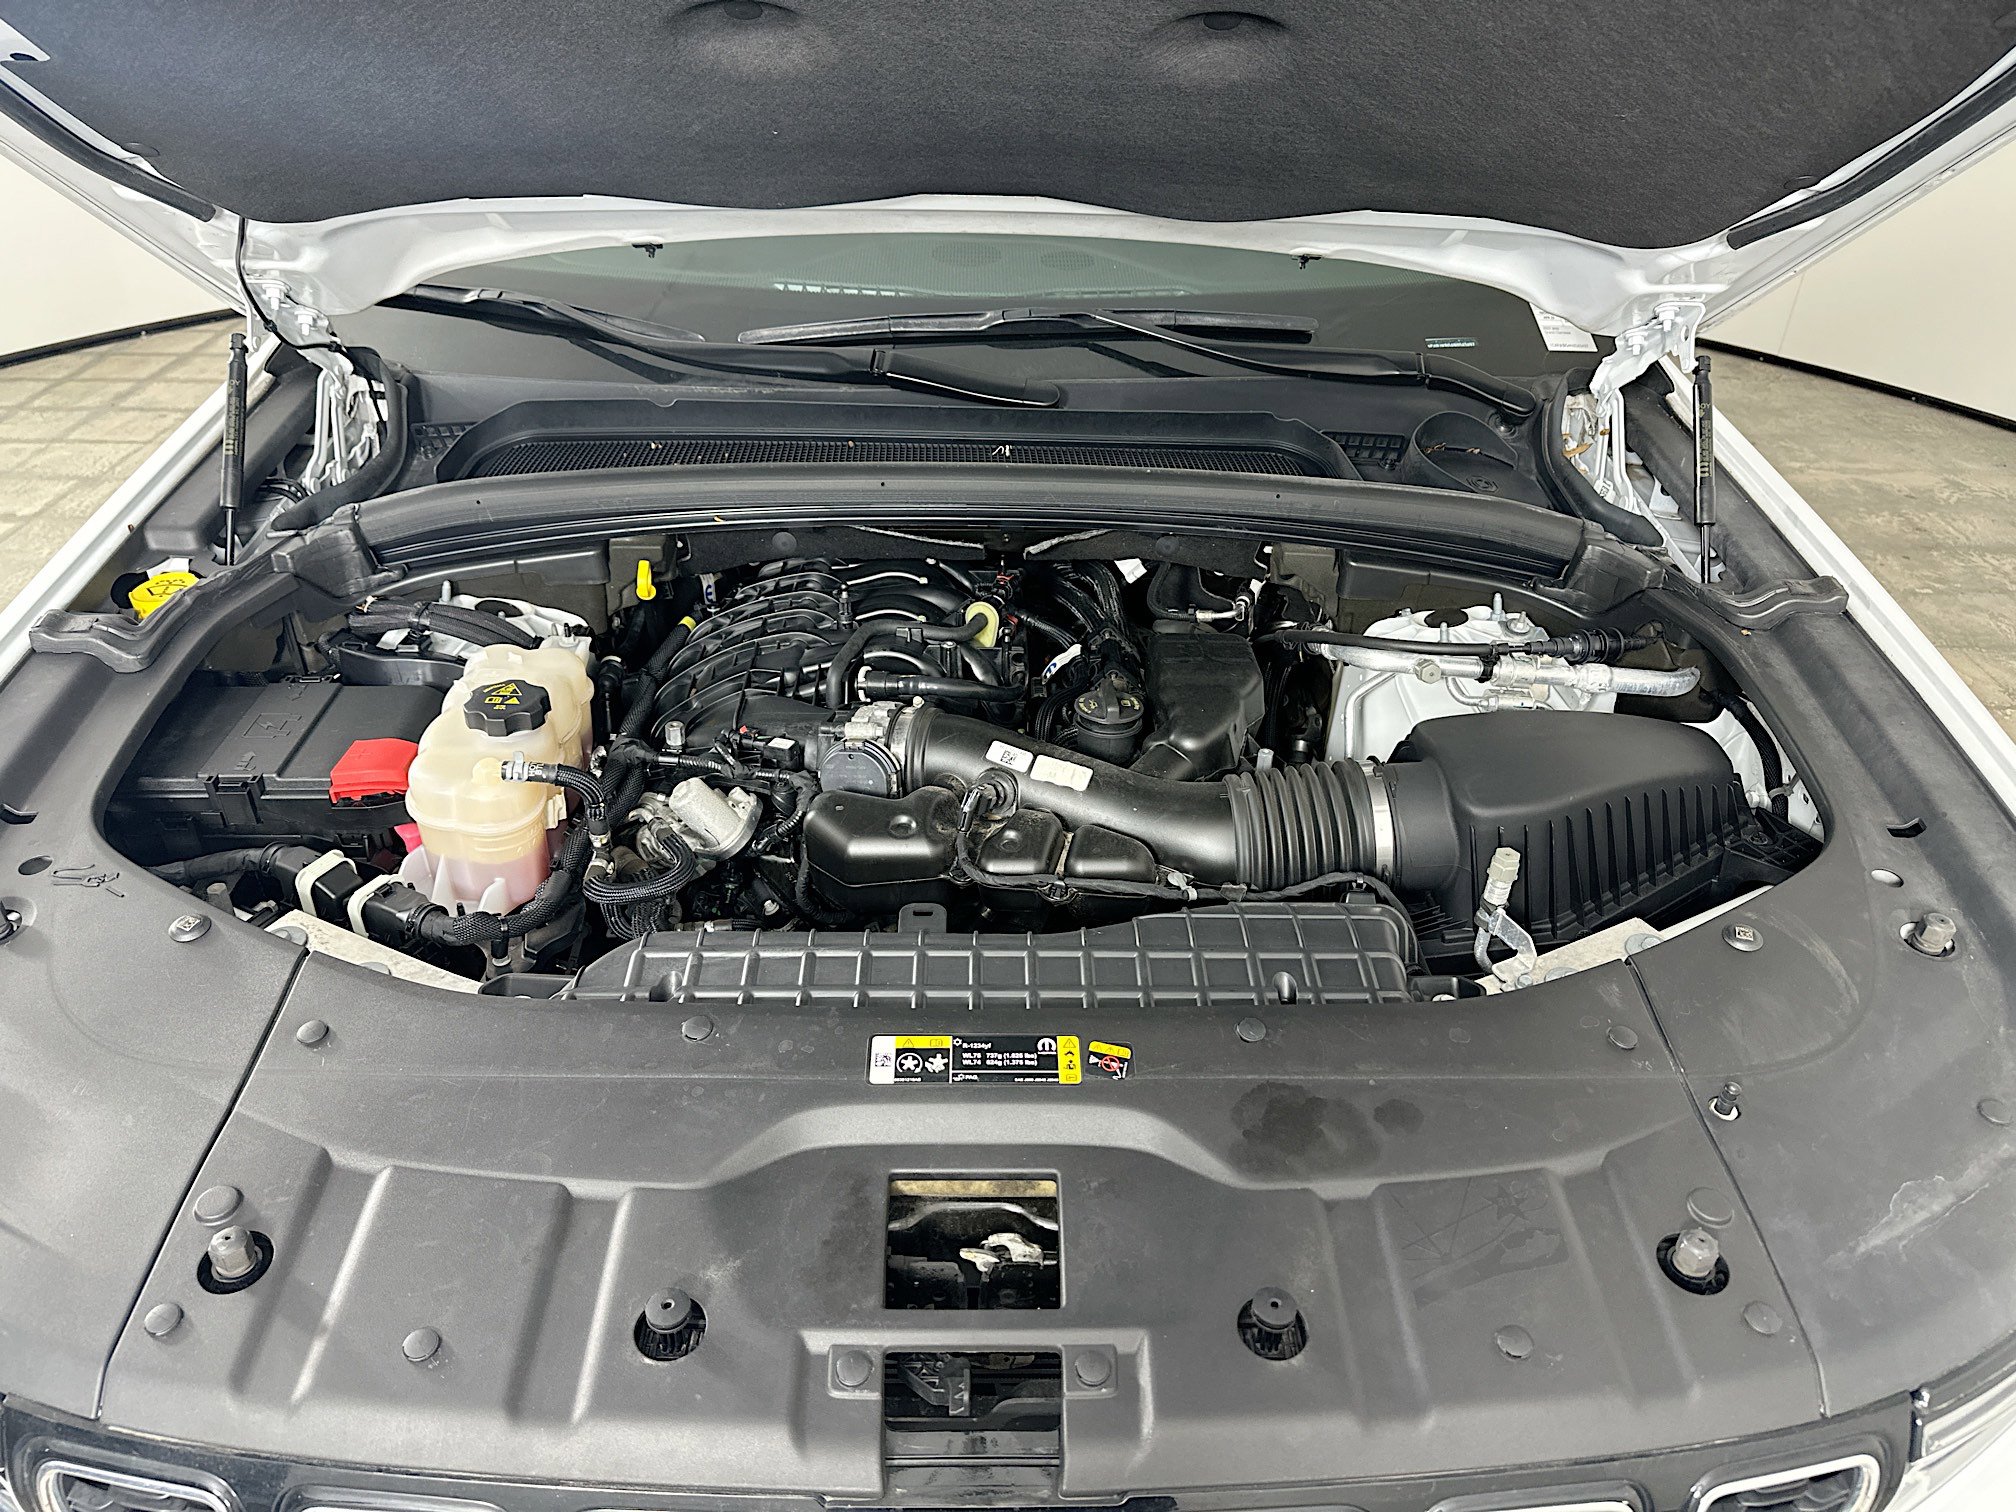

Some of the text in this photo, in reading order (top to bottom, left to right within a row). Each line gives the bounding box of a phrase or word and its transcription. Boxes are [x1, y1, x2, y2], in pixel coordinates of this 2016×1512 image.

[962, 1042, 991, 1050] R-1234yf
[985, 1052, 1003, 1060] 737g
[1024, 1052, 1038, 1060] lbs)
[1024, 1059, 1038, 1067] lbs)
